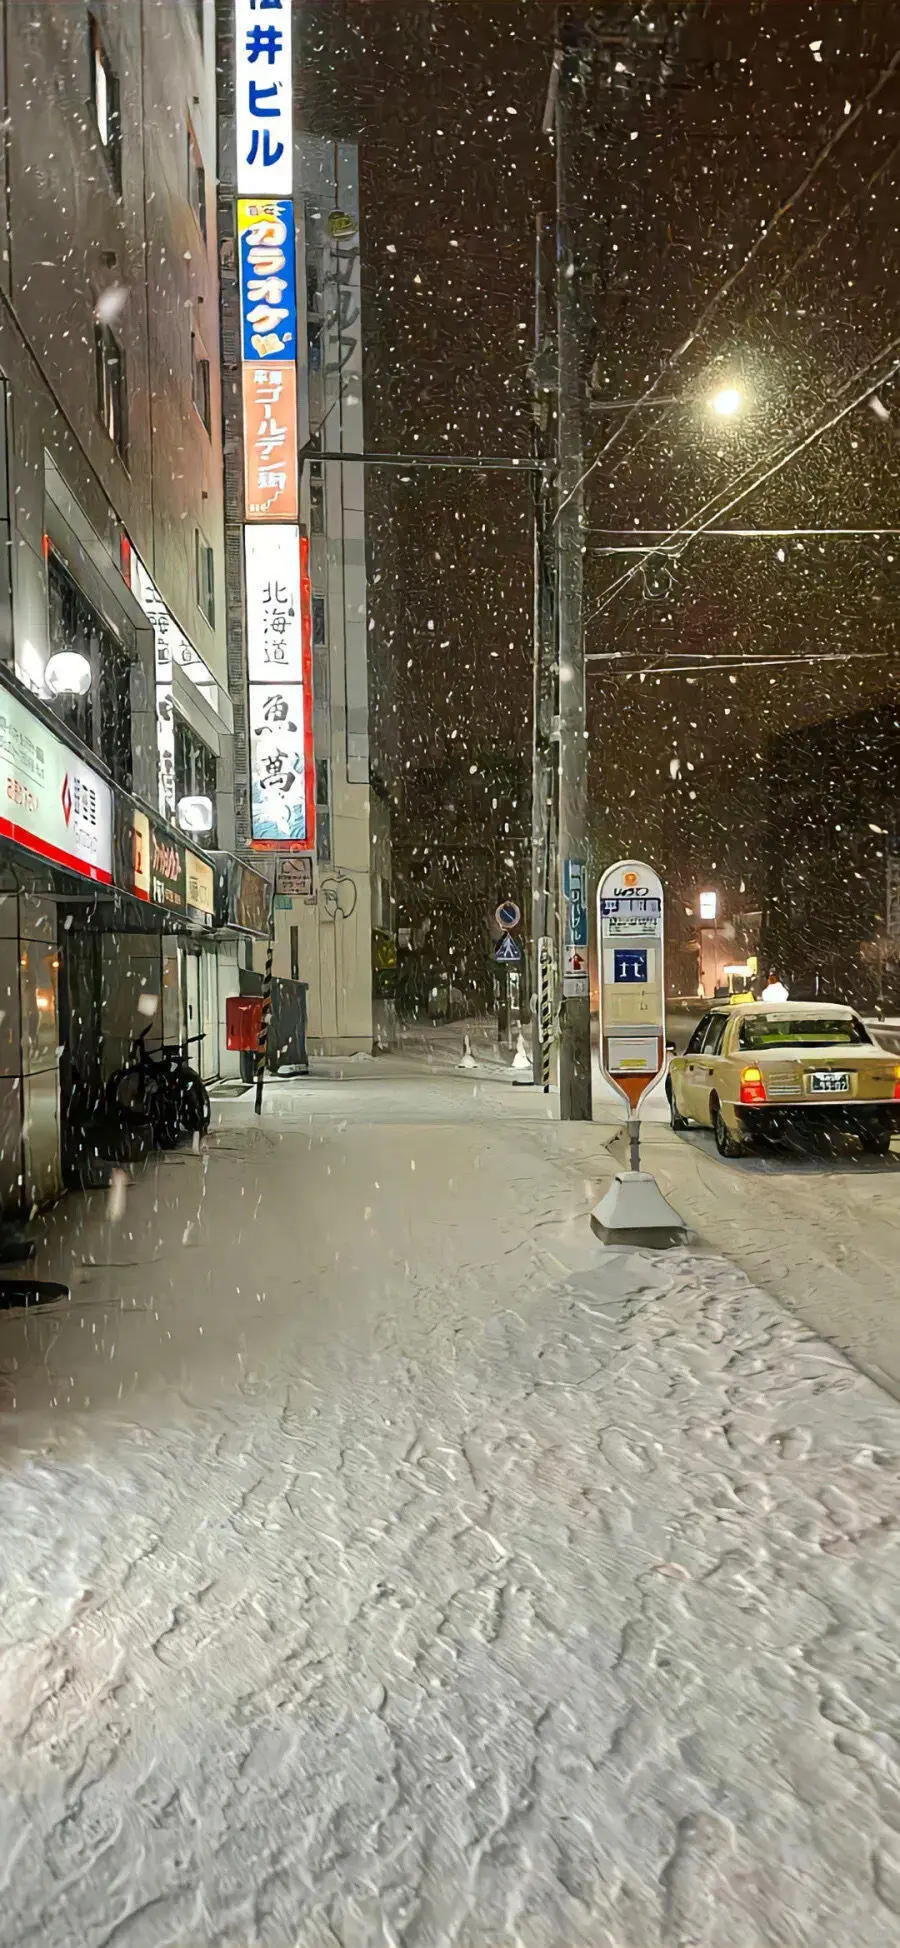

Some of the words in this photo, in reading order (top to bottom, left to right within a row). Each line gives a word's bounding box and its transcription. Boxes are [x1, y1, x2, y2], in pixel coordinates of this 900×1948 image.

[244, 218, 291, 334] カラオケ
[262, 580, 291, 665] 北海道
[255, 694, 298, 794] 魚萬
